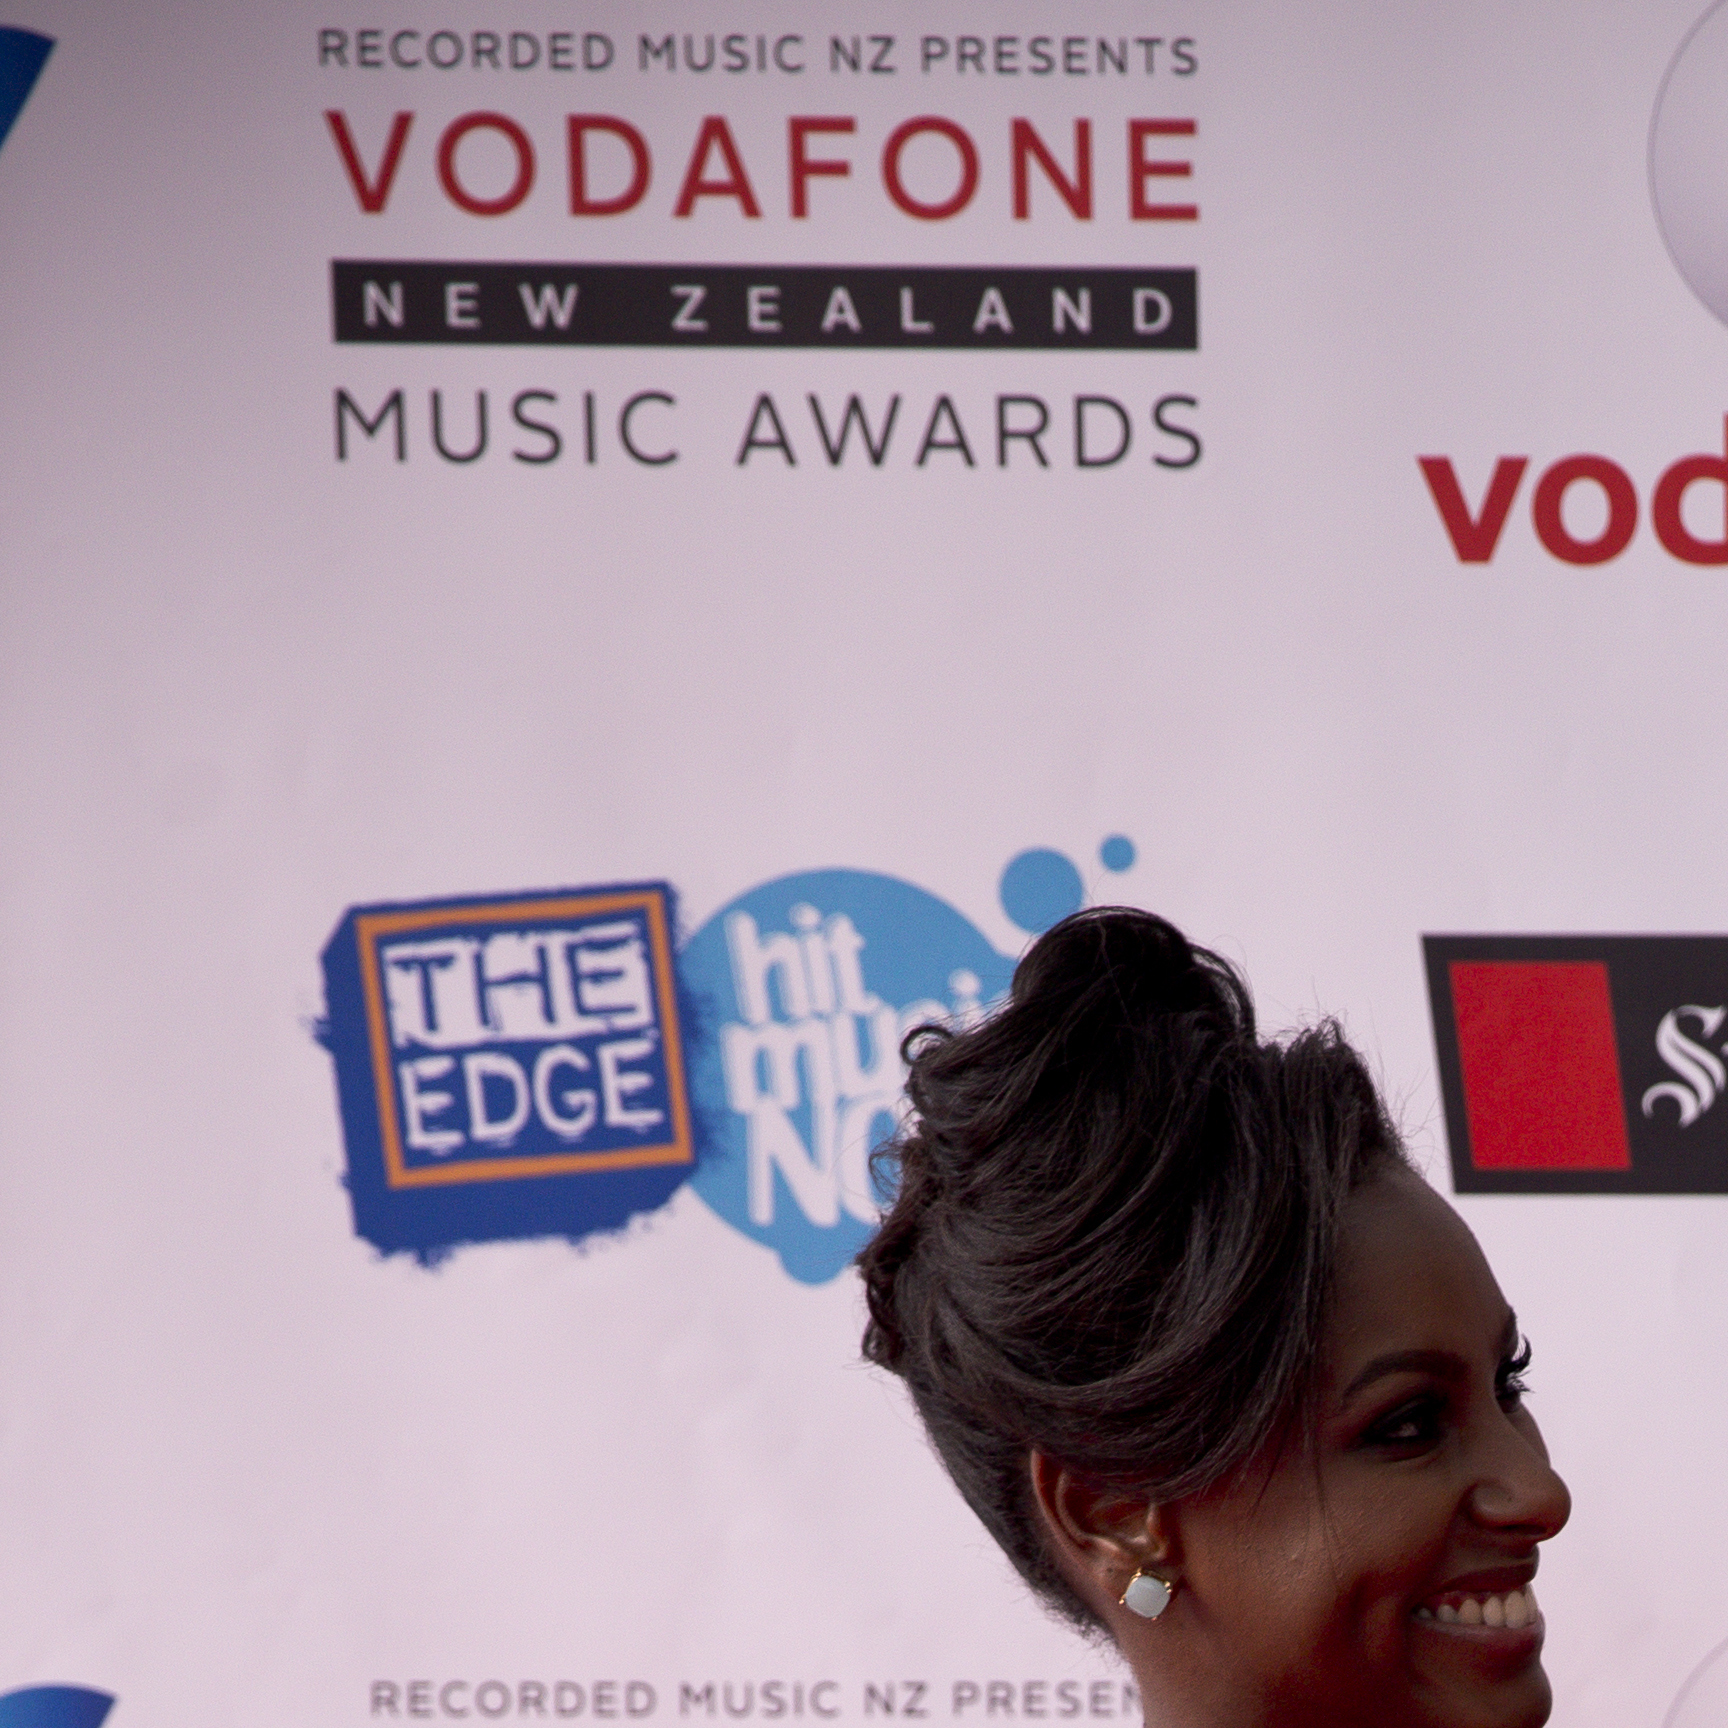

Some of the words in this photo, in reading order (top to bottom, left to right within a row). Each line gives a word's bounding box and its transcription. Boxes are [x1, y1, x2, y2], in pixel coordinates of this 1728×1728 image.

[316, 26, 615, 73] RECORDED
[637, 32, 805, 75] MUSIC
[829, 34, 896, 76] NZ
[920, 34, 1199, 78] PRESENTS
[322, 108, 1199, 222] VODAFONE
[363, 281, 579, 329] NEW
[671, 284, 1173, 335] ZEALAND
[332, 386, 679, 468] MUSIC
[735, 392, 1204, 472] AWARDS
[382, 924, 650, 1048] THE
[723, 902, 866, 1026] hit
[402, 1040, 666, 1152] EDGE
[369, 1679, 658, 1720] RECORDED
[678, 1679, 839, 1720] MUSIC
[864, 1680, 928, 1719] NZ
